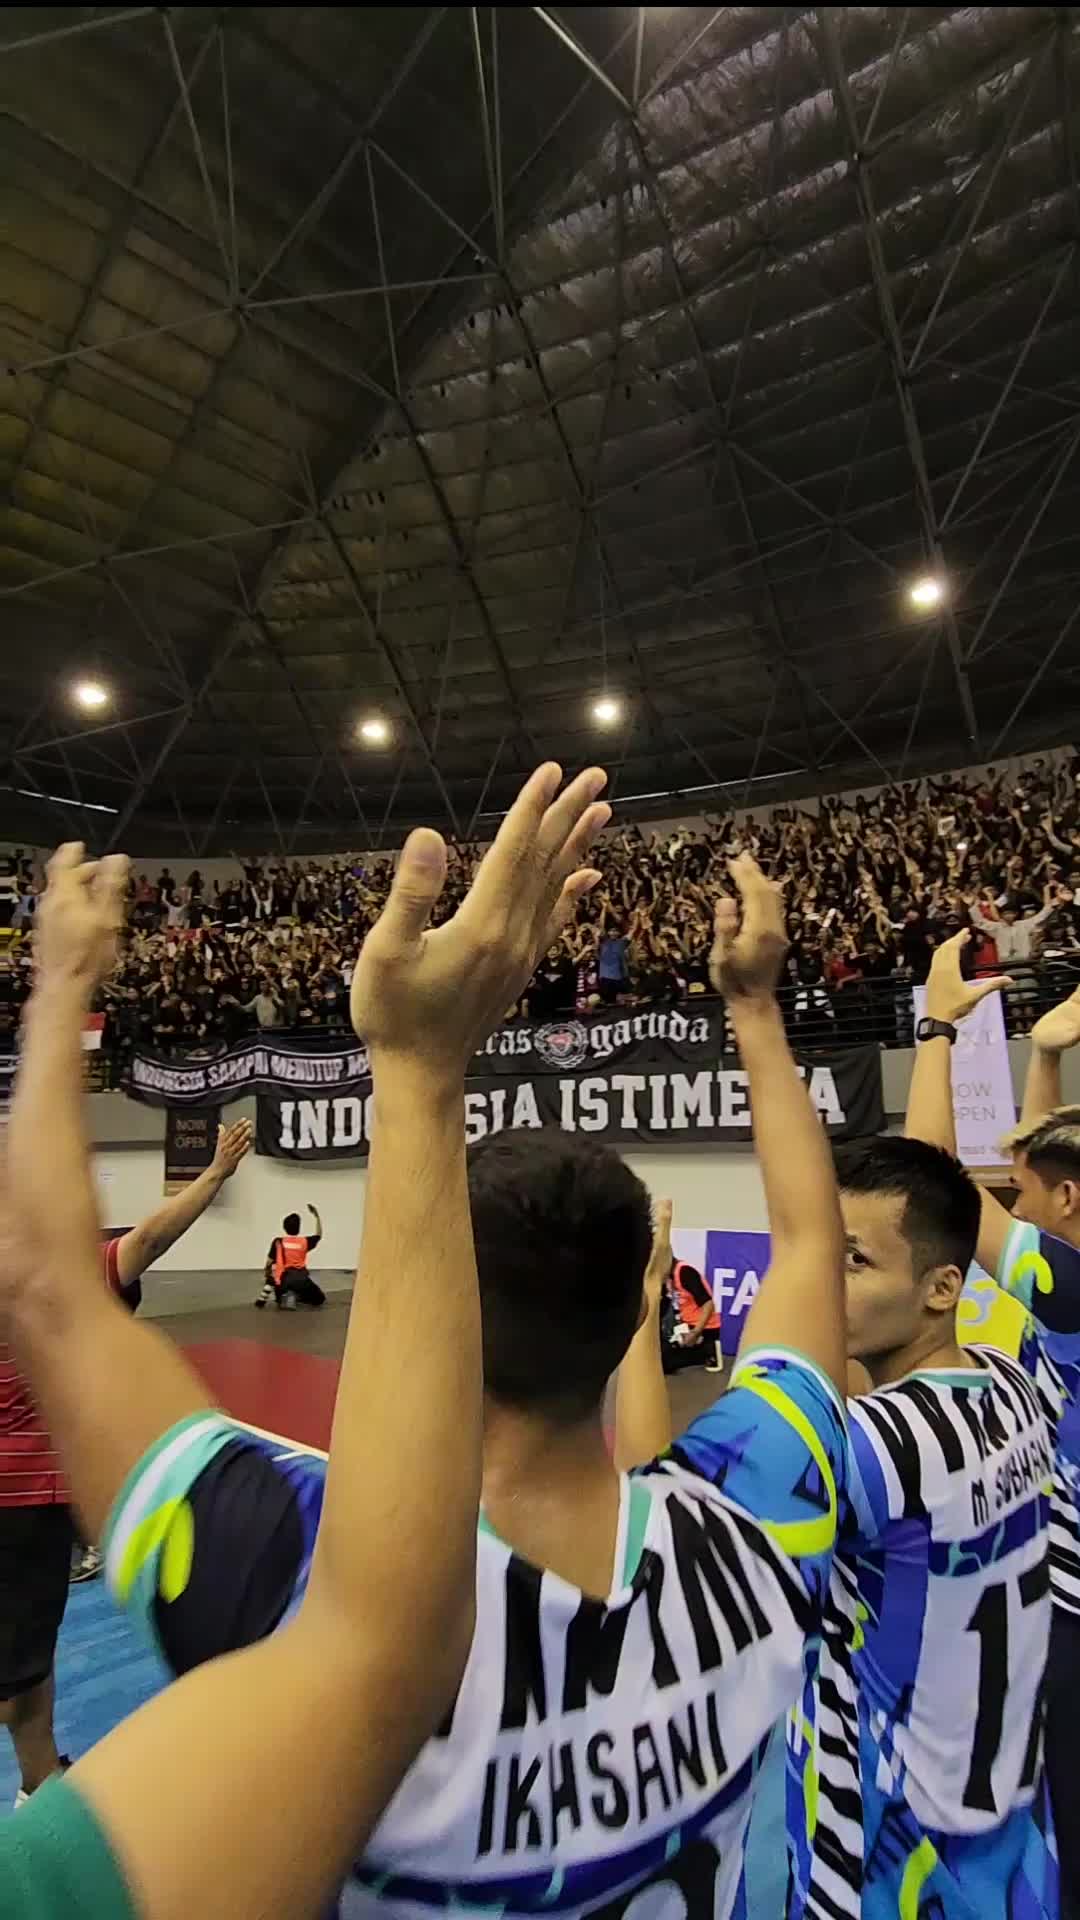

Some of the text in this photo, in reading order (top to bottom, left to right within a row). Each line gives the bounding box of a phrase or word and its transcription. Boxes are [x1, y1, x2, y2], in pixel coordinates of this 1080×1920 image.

[589, 1009, 710, 1058] garuda
[559, 1066, 847, 1133] ISTIMEA
[955, 1105, 997, 1121] PEN
[956, 1082, 993, 1098] OW
[474, 1691, 729, 1857] IKHSANI
